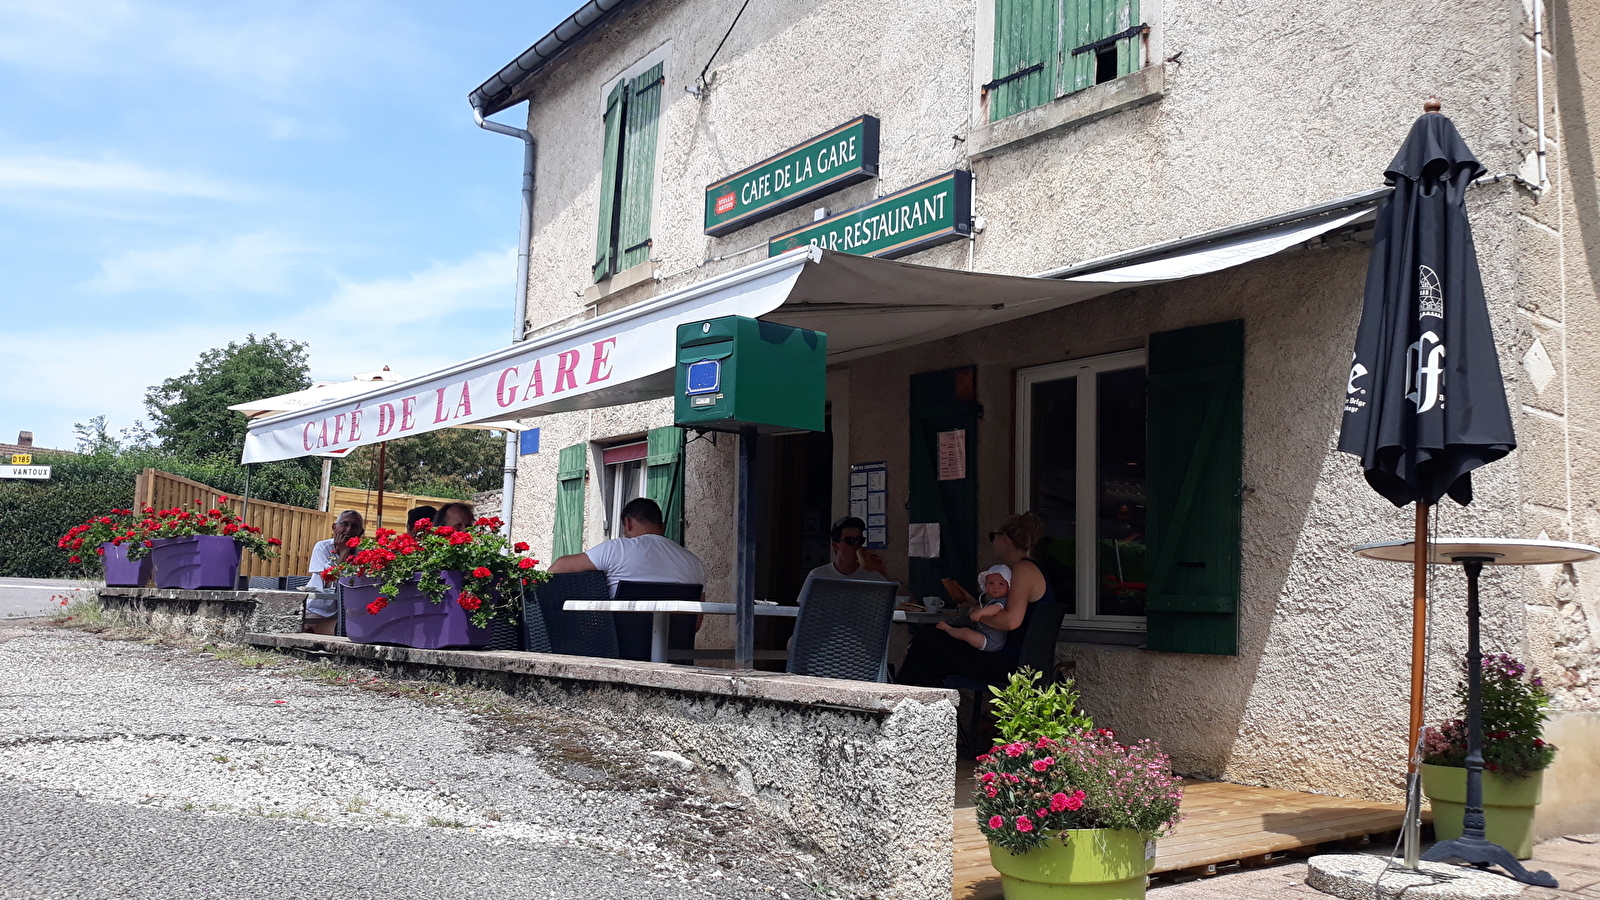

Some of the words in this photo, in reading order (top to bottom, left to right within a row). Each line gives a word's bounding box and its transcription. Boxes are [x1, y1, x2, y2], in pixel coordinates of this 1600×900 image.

[741, 173, 770, 205] CAFE
[774, 164, 791, 192] DE
[795, 156, 813, 184] LA
[817, 135, 856, 174] GARE
[303, 402, 363, 452] CAFÉ
[376, 396, 416, 437] DE
[433, 380, 472, 425] LA
[497, 337, 617, 408] GARE
